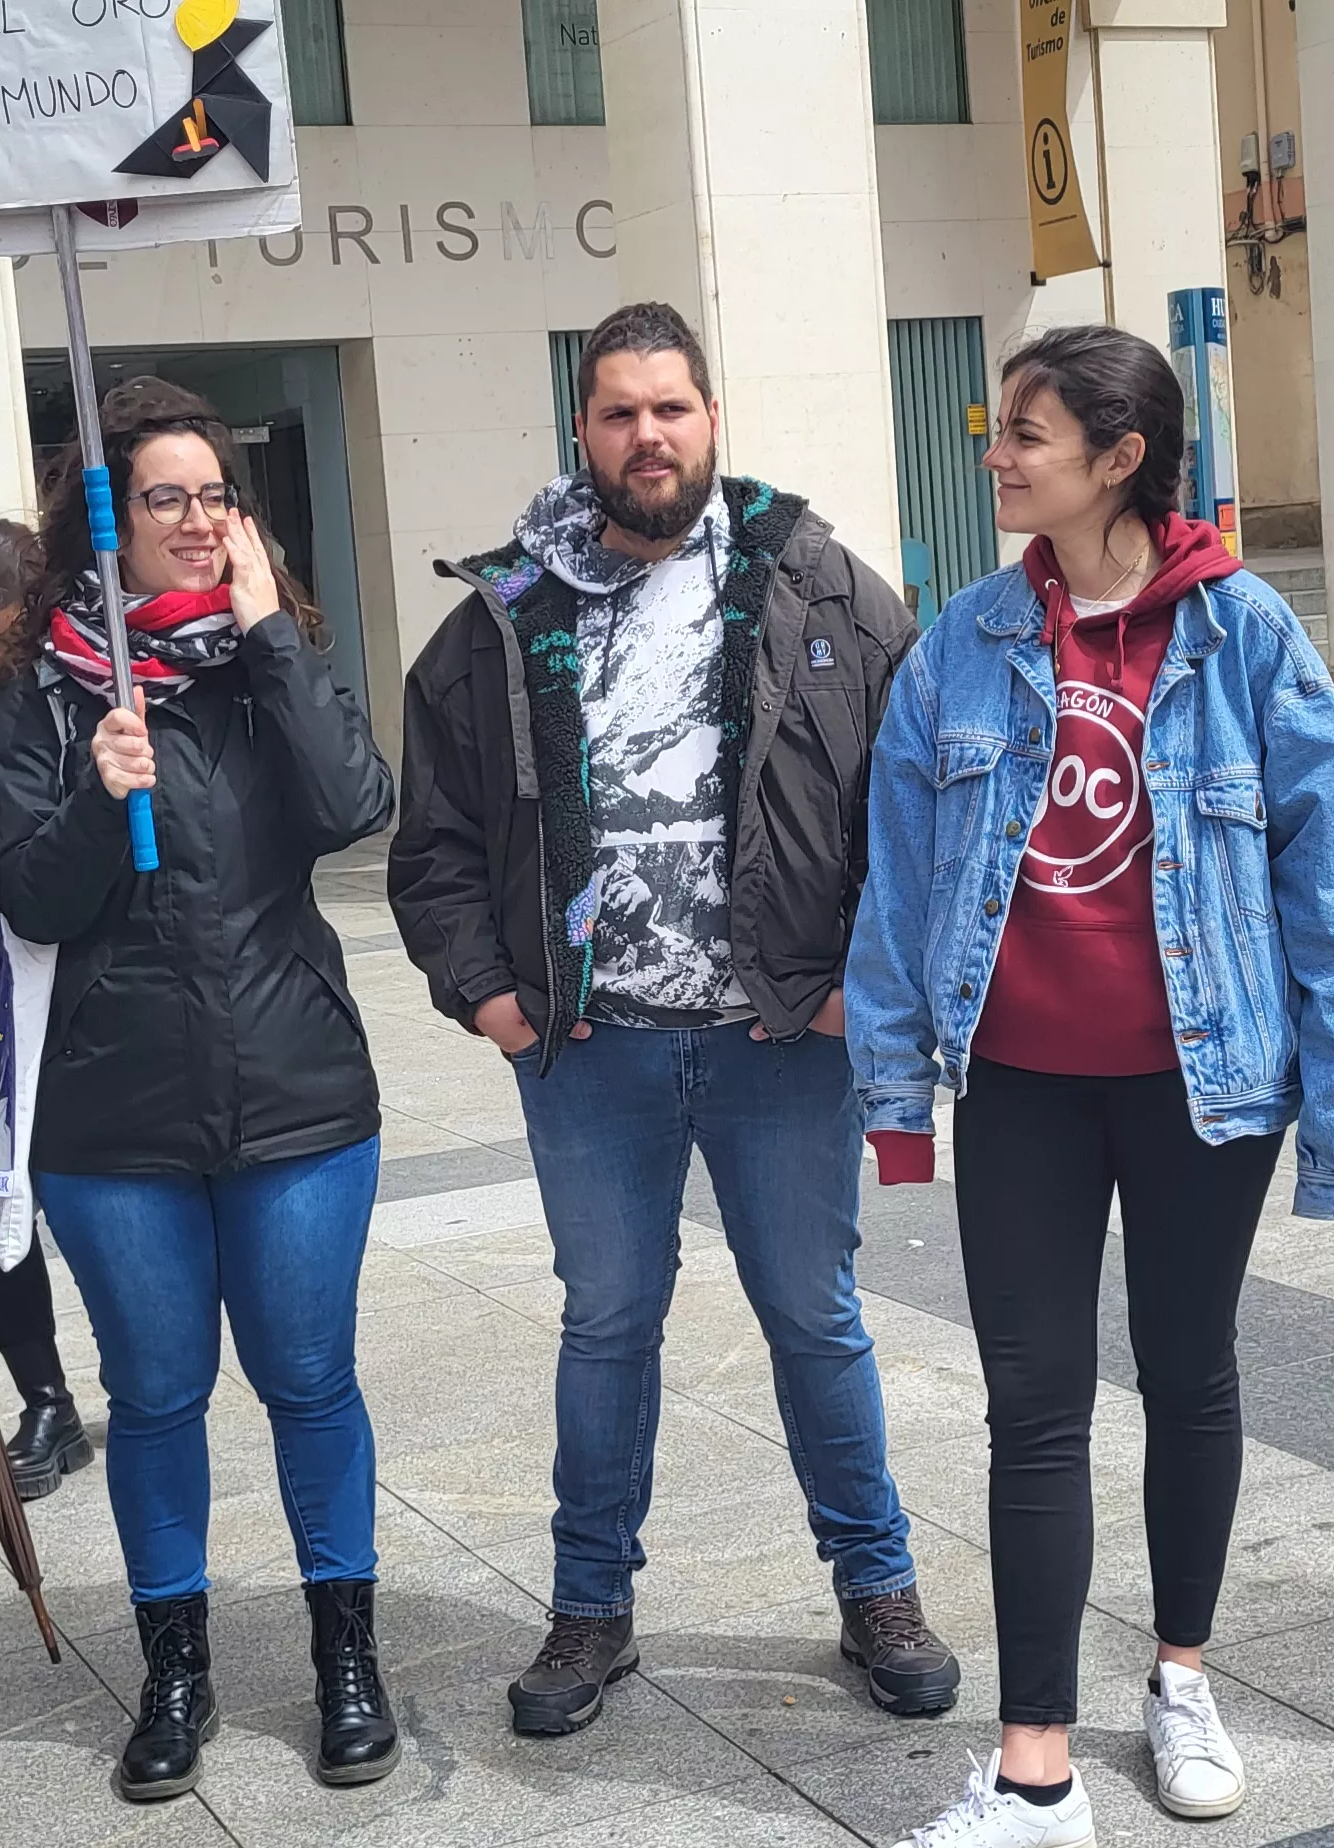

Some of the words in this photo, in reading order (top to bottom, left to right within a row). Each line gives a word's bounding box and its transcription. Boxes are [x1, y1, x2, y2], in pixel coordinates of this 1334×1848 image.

[1050, 6, 1066, 27] de
[1026, 37, 1064, 63] Turismo
[1, 69, 138, 125] MUNDO
[1032, 754, 1124, 829] OC
